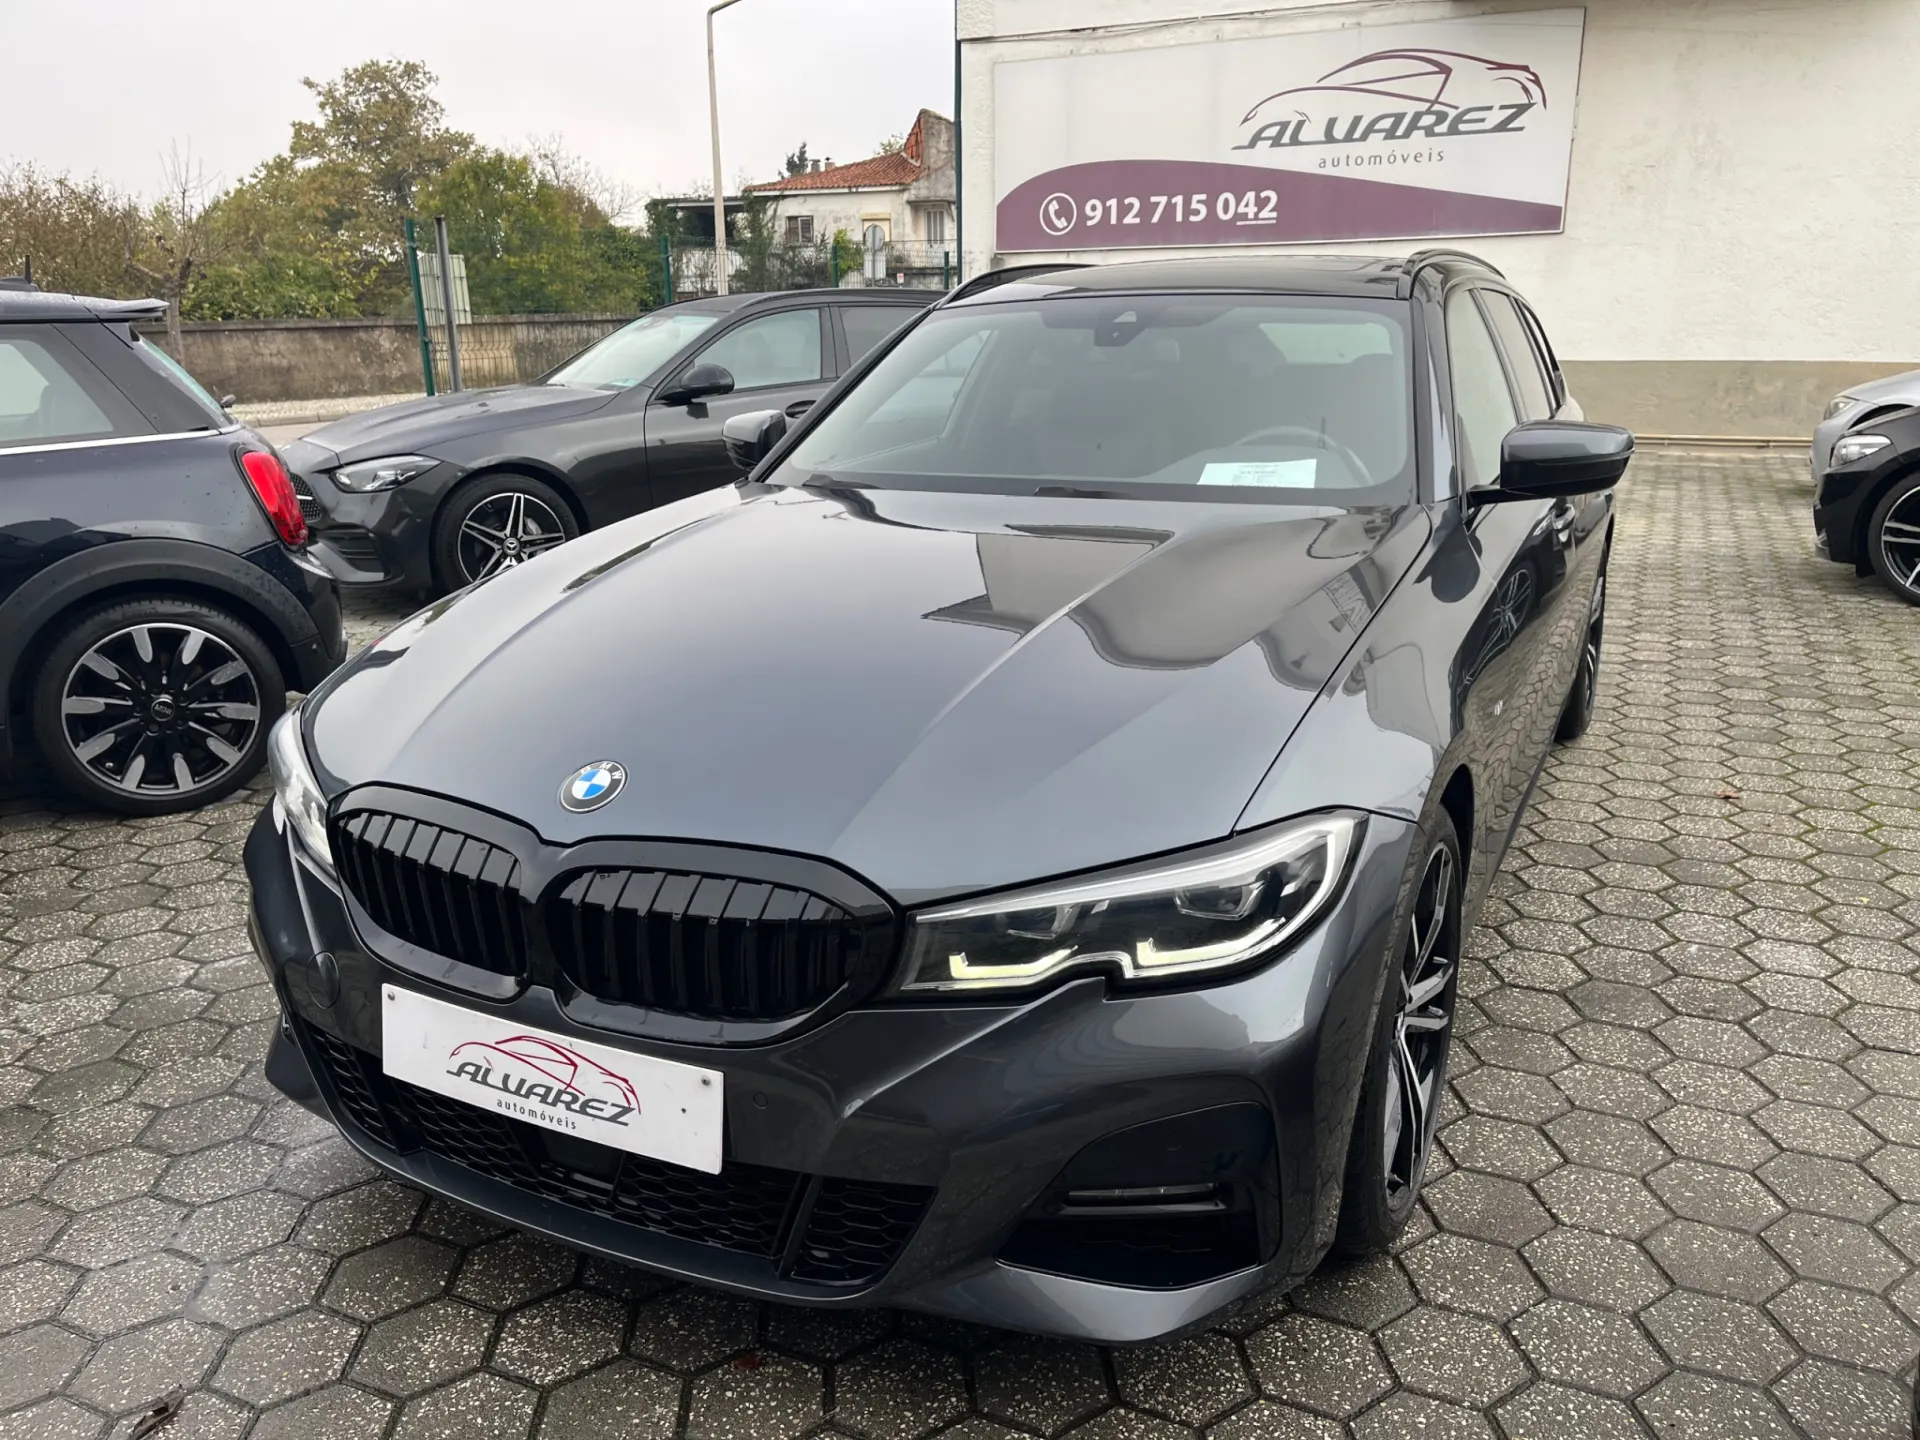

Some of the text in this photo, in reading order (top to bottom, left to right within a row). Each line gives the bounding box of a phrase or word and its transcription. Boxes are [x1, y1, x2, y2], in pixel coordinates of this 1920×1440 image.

[1317, 148, 1446, 169] automóveis
[1085, 190, 1279, 226] 912 715 042
[496, 1099, 577, 1130] automóveis
